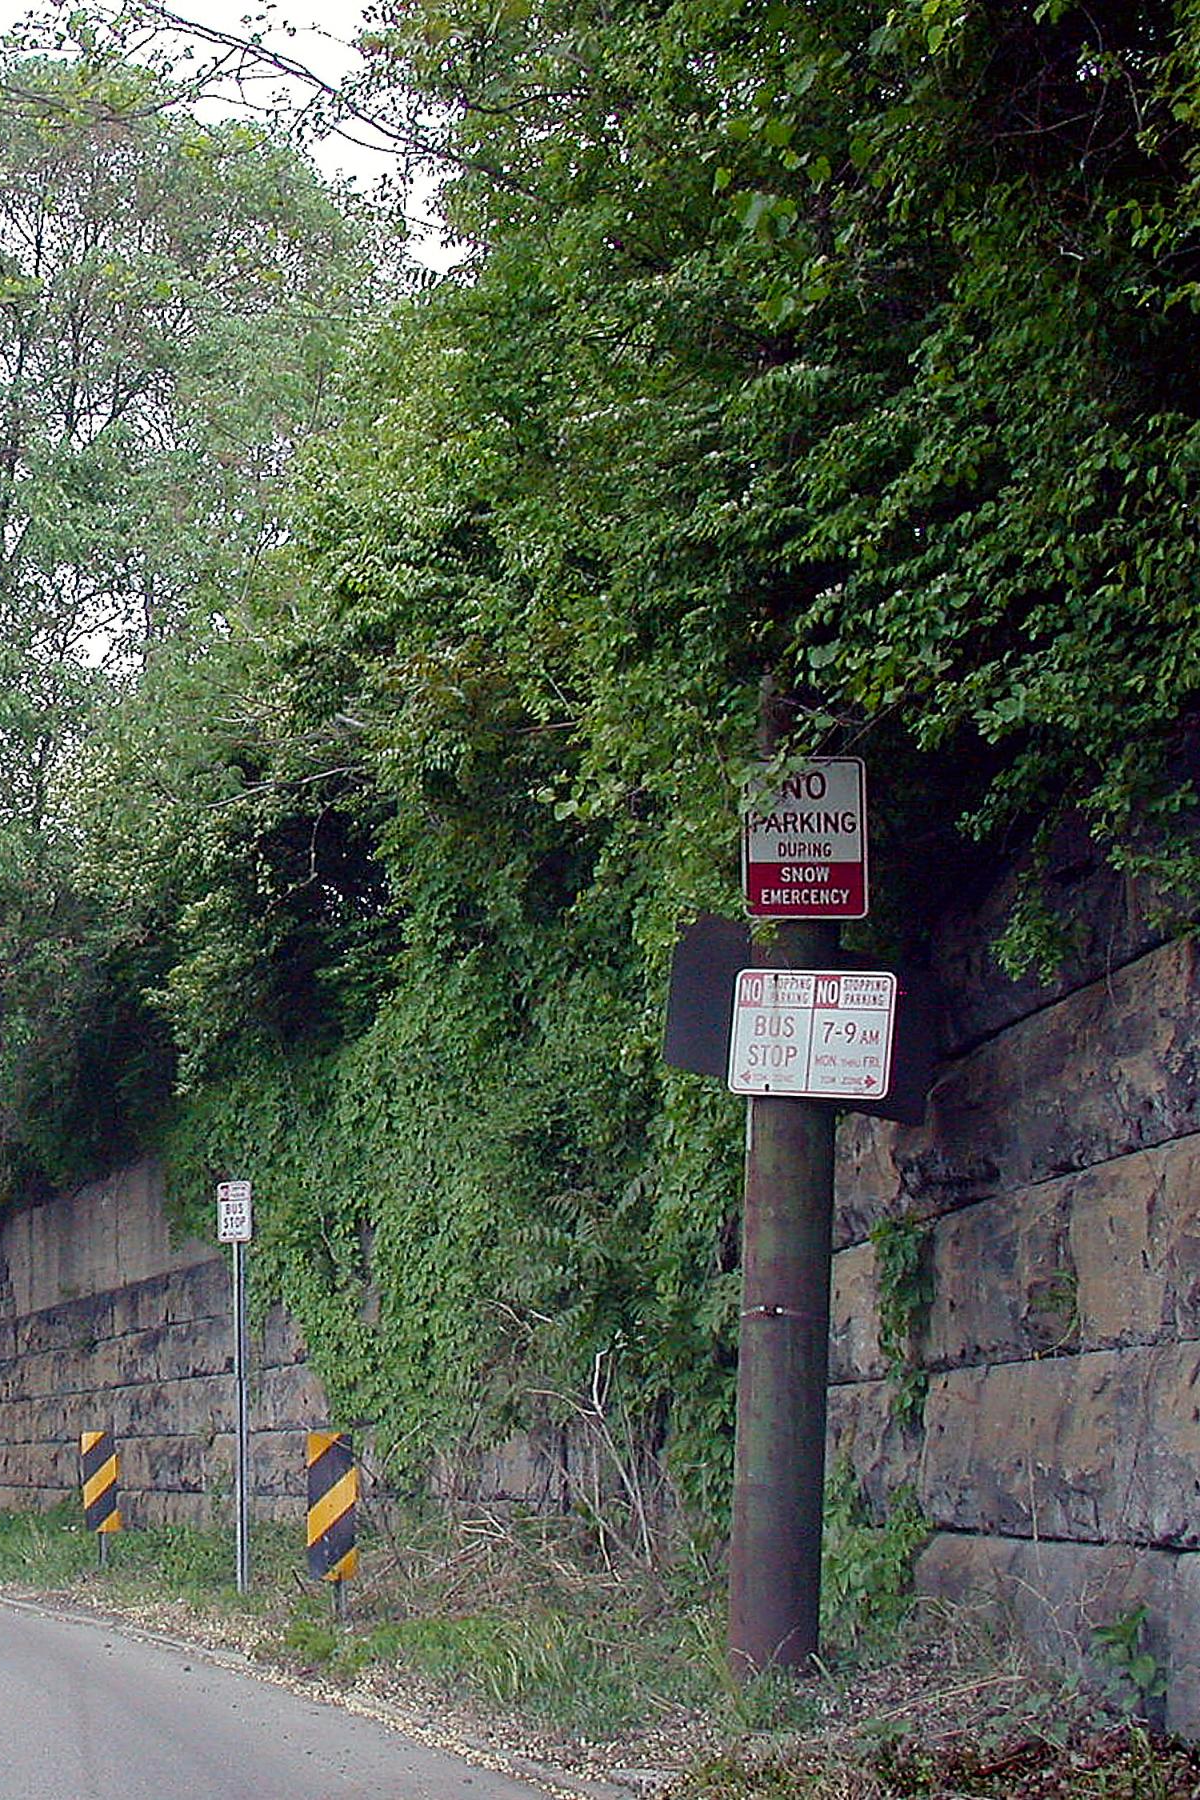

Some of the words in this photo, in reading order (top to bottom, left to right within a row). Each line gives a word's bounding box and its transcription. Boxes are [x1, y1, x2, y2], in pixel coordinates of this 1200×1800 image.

[781, 772, 826, 800] NO
[752, 811, 857, 834] PARKING
[778, 842, 832, 857] DURING
[780, 867, 830, 883] SNOW
[761, 889, 850, 905] EMERGENCY
[741, 979, 762, 1001] NO
[816, 980, 839, 1004] NO
[754, 1015, 795, 1038] BUS
[823, 1021, 857, 1044] 7-9
[860, 1030, 880, 1045] AM
[748, 1045, 797, 1068] STOP
[226, 1203, 243, 1215] BUS
[224, 1216, 246, 1229] STOP
